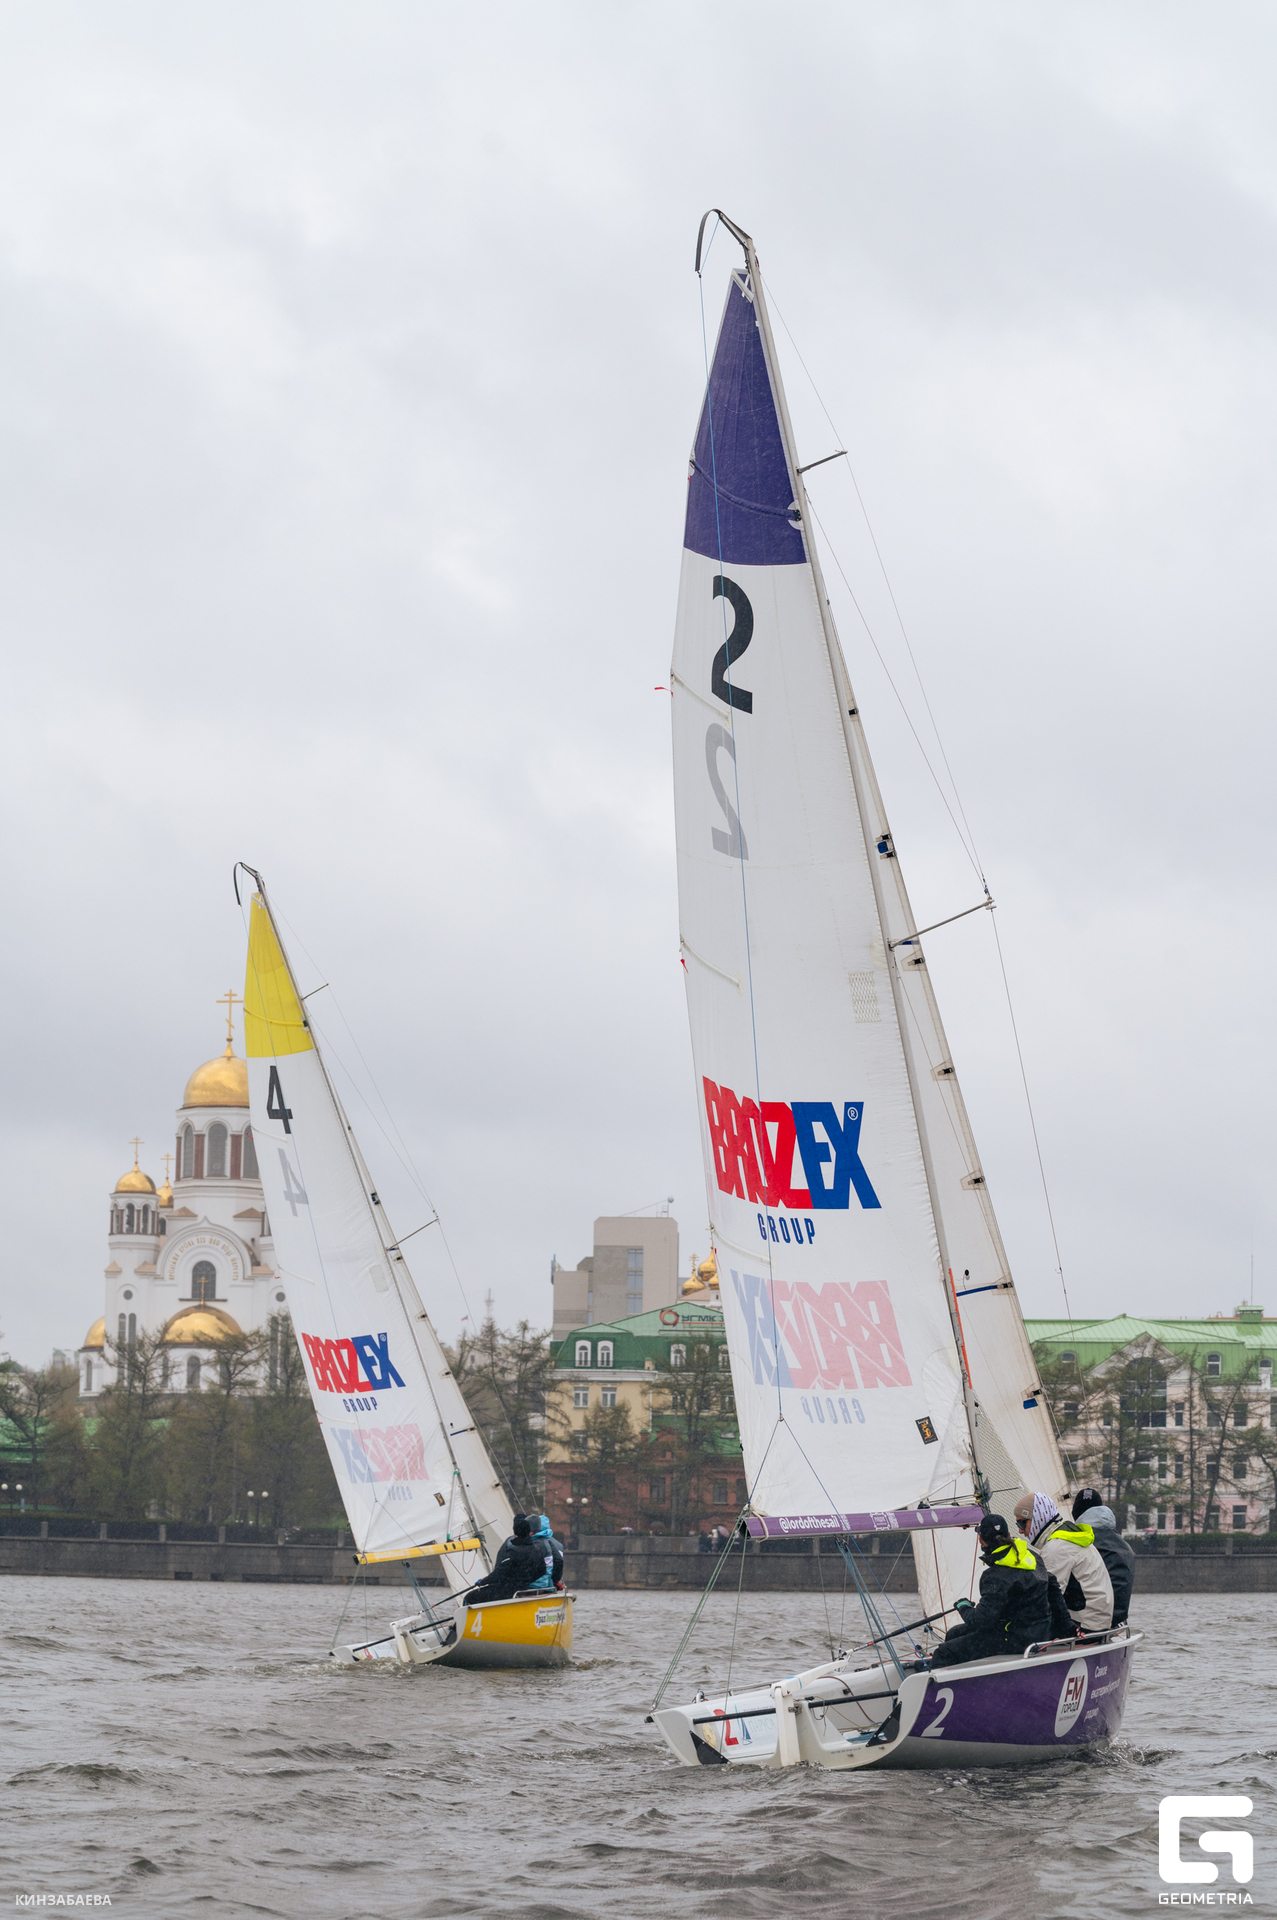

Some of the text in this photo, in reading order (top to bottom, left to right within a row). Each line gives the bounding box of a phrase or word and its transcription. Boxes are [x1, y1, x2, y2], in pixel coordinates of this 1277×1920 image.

[711, 575, 754, 714] 2
[267, 1066, 293, 1134] 4
[757, 1213, 816, 1245] GROUP
[342, 1397, 378, 1412] GROUP
[779, 1514, 840, 1533] @lordofthesail
[470, 1611, 483, 1637] 4
[1064, 1675, 1085, 1710] FM
[920, 1687, 954, 1737] 2
